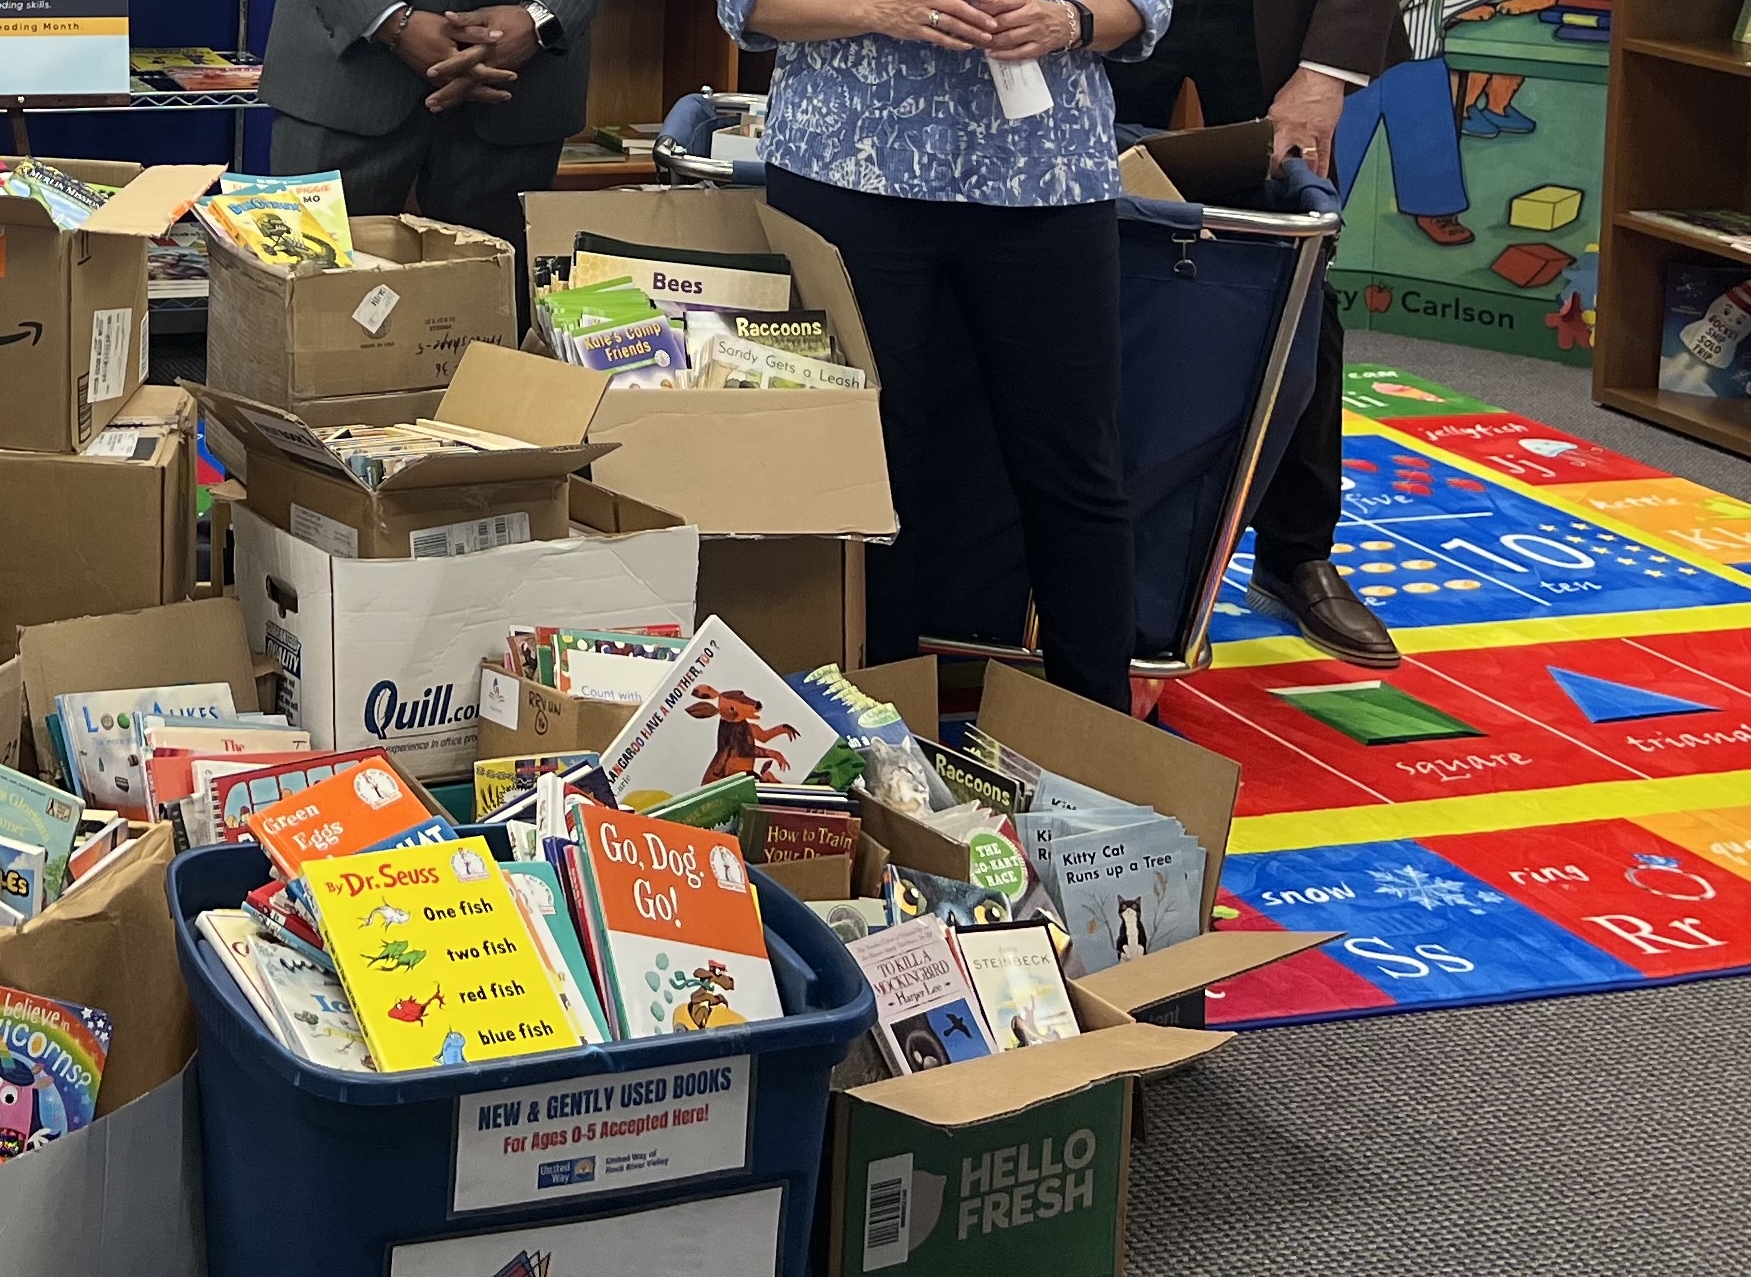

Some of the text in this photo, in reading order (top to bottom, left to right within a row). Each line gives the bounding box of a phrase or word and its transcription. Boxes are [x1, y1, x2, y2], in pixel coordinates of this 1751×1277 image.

[652, 271, 703, 295] Bees
[1401, 290, 1515, 330] Carlson
[735, 317, 822, 338] Raccoons
[718, 340, 861, 390] Sandy Gets a Leash
[1423, 422, 1529, 442] jellyfish
[1440, 533, 1596, 573] 10
[1539, 579, 1603, 595] ten
[581, 685, 642, 703] Count with
[934, 753, 1012, 807] Raccoons
[1395, 749, 1533, 782] square
[262, 803, 320, 835] Green
[291, 820, 345, 851] Eggs
[767, 825, 853, 850] How to Train
[600, 822, 705, 888] Go, Dog.
[1062, 843, 1126, 867] Kitty Cat
[1066, 853, 1173, 885] Runs up a Tree
[340, 863, 440, 898] Dr. Seuss
[1507, 862, 1591, 891] ring
[423, 897, 494, 922] One fish
[633, 882, 682, 928] Go!
[1262, 882, 1357, 906] snow
[446, 937, 518, 962] two fish
[1580, 913, 1728, 956] Rr
[973, 954, 1051, 971] STEINBECK
[1343, 936, 1475, 982] Ss
[459, 979, 526, 1004] red fish
[477, 1020, 554, 1046] blue fish
[478, 1067, 732, 1132] NEW & GENTLY USED BOOKS
[503, 1103, 709, 1155] For Ages 0-5 Accepted Here!
[959, 1128, 1096, 1197] HELLO
[957, 1168, 1094, 1241] FRESH
